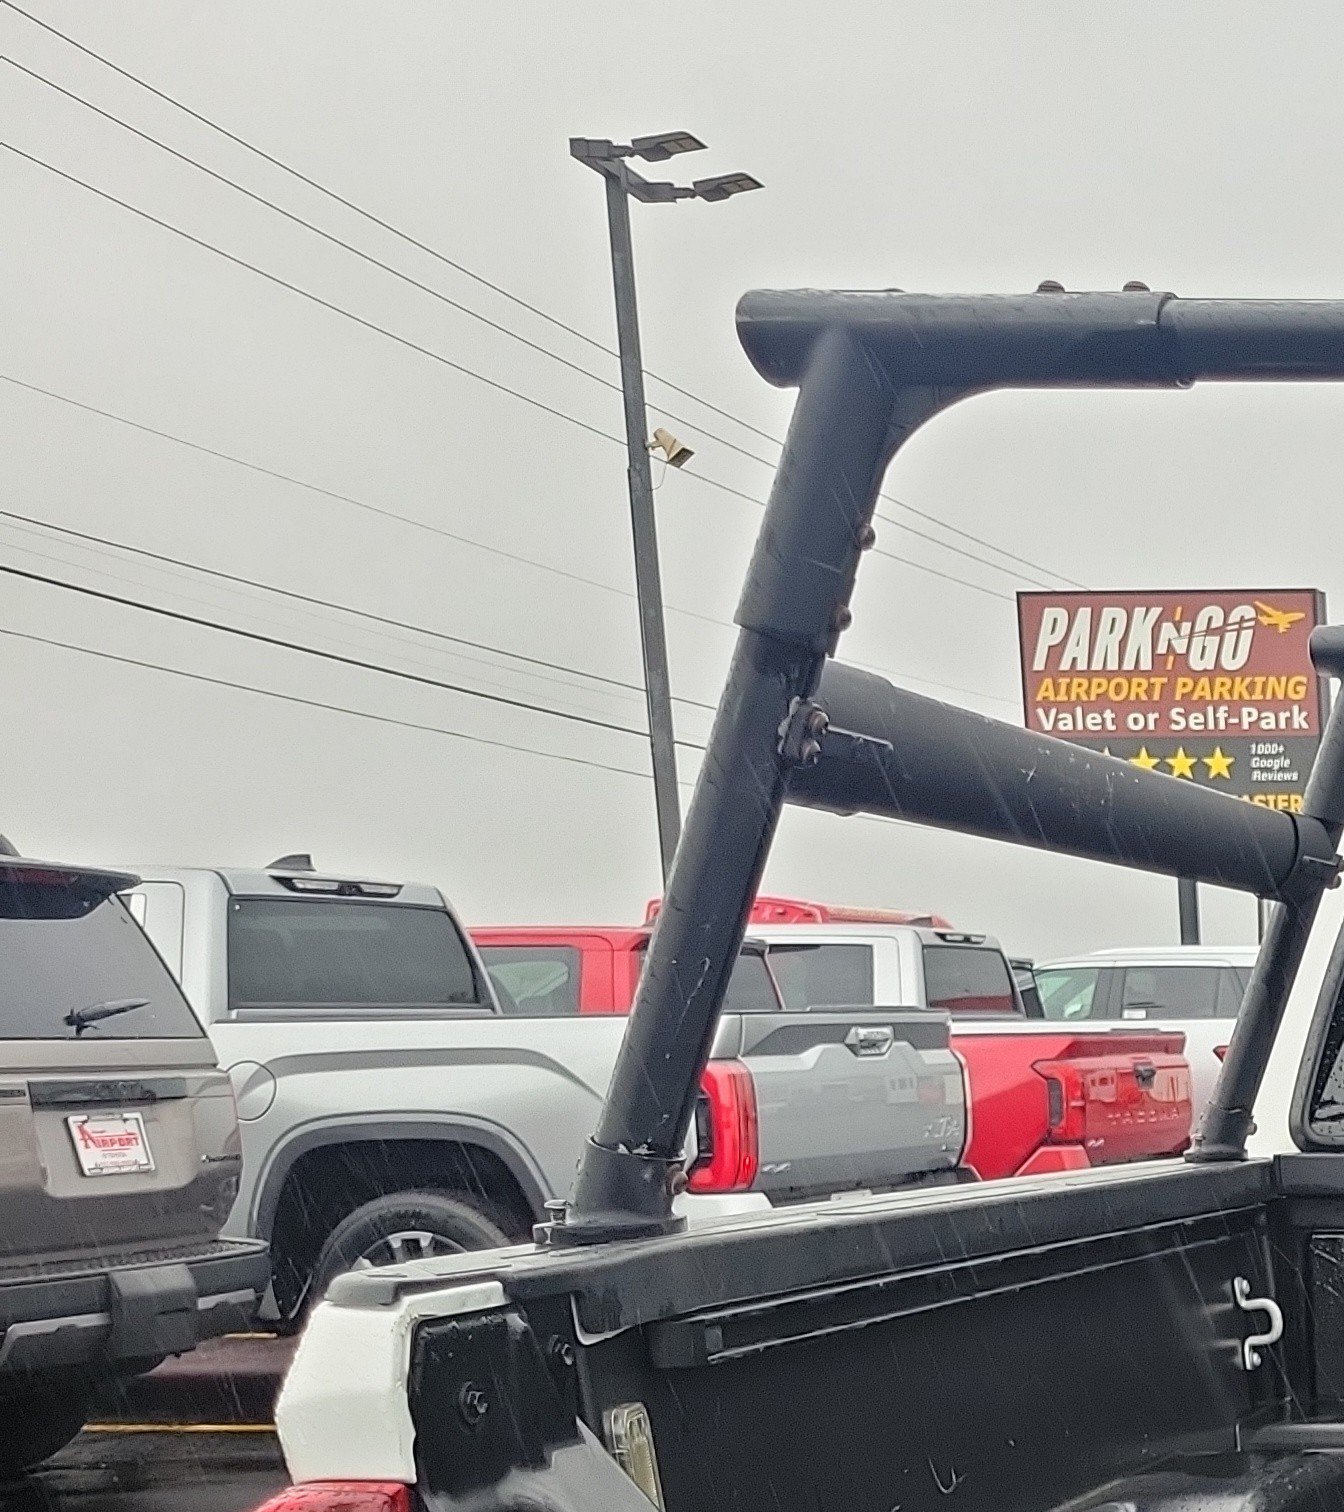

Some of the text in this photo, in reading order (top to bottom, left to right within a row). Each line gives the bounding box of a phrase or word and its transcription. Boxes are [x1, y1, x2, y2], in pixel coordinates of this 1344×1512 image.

[1032, 606, 1163, 672] PARK
[1189, 605, 1257, 671] GO
[1036, 676, 1307, 702] AIRPORT PARKING
[1036, 705, 1309, 731] Valet or Self-Park
[1250, 743, 1285, 754] 1000+
[1251, 756, 1291, 770] Google
[1251, 770, 1299, 781] Reviews
[78, 1124, 139, 1149] AIRPORT
